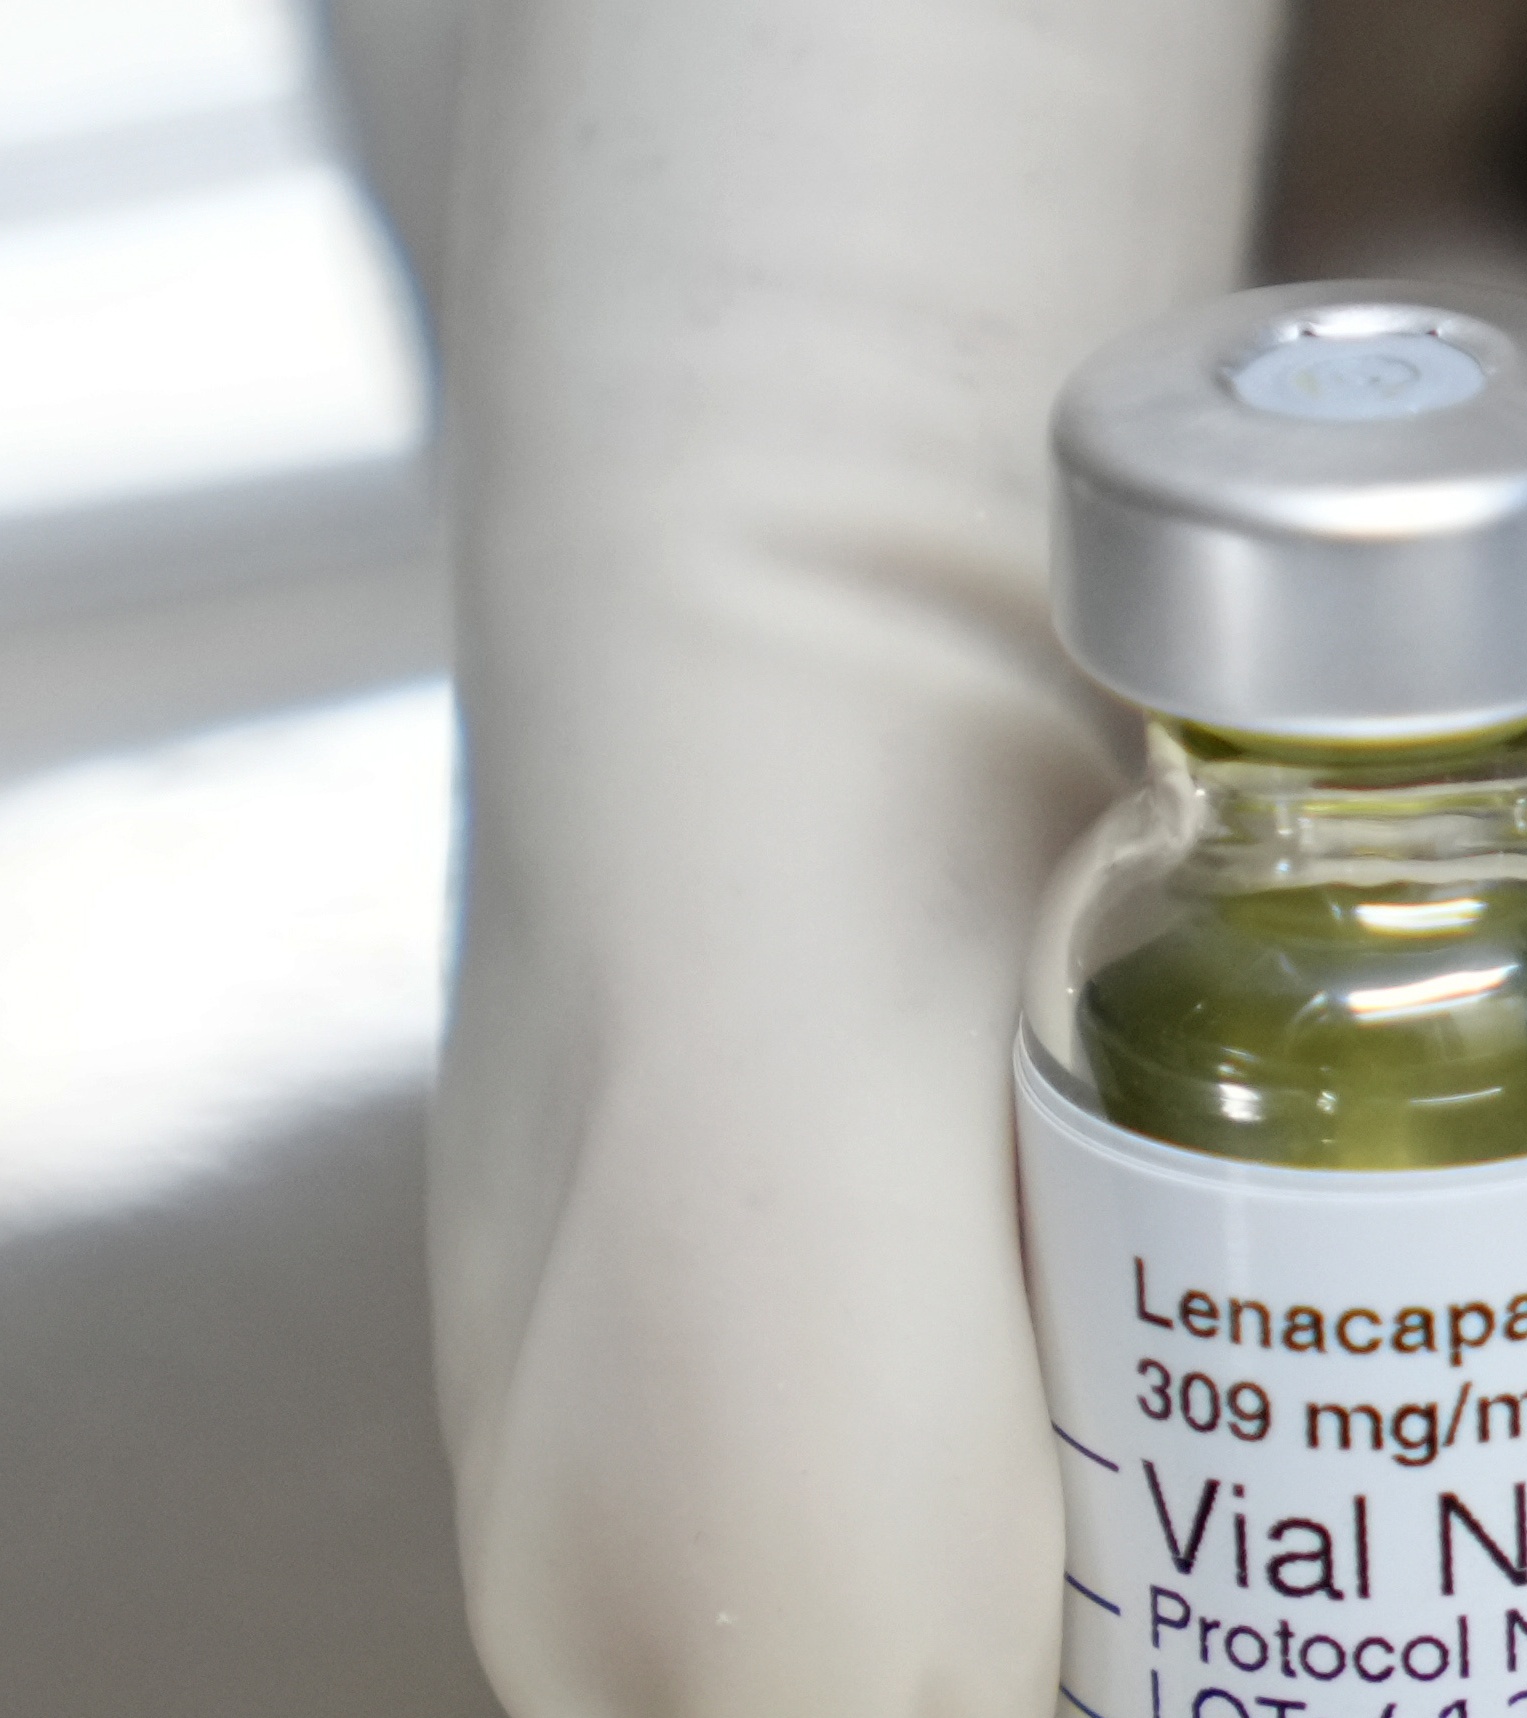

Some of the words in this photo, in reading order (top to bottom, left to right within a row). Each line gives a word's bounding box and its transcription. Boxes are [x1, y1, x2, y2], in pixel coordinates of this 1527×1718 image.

[1136, 1357, 1273, 1443] 309
[1142, 1458, 1372, 1602] Vial
[1149, 1584, 1471, 1684] Protocol
